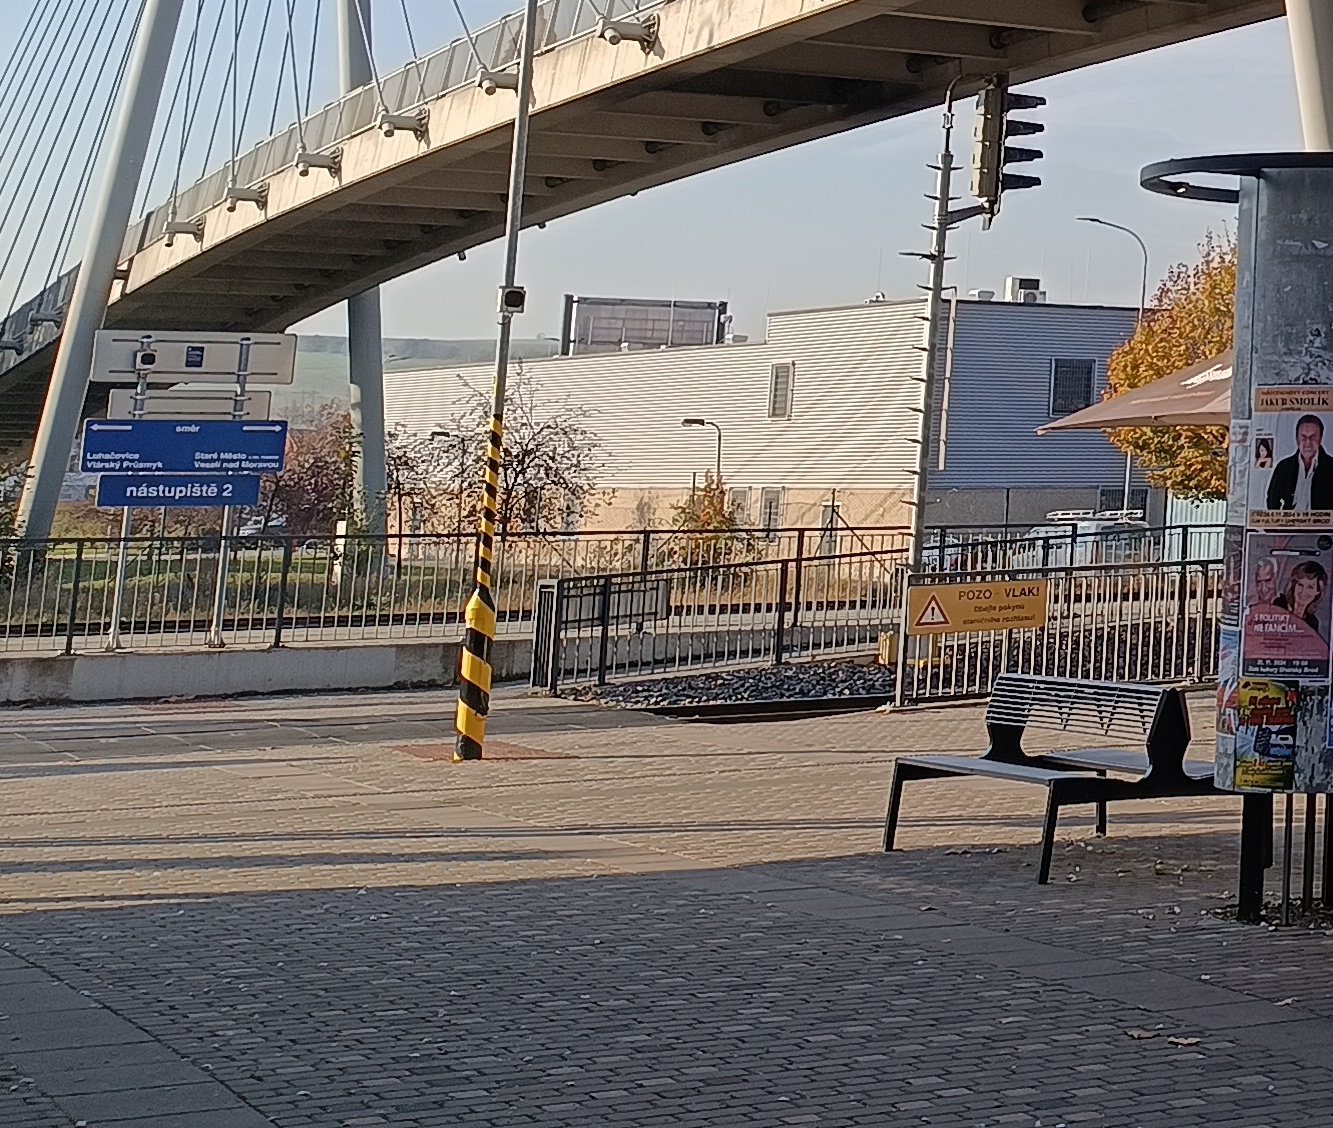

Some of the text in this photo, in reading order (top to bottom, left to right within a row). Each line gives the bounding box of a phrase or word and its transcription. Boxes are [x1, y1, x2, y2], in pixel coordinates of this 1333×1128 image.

[1260, 395, 1329, 406] JAKUB SMOLÍK
[175, 424, 200, 433] směr
[86, 451, 140, 460] Luhačovice
[194, 451, 219, 460] Staré
[222, 461, 240, 469] nad
[125, 483, 233, 500] nástupiště 2
[958, 586, 1040, 601] POZO VLAK!
